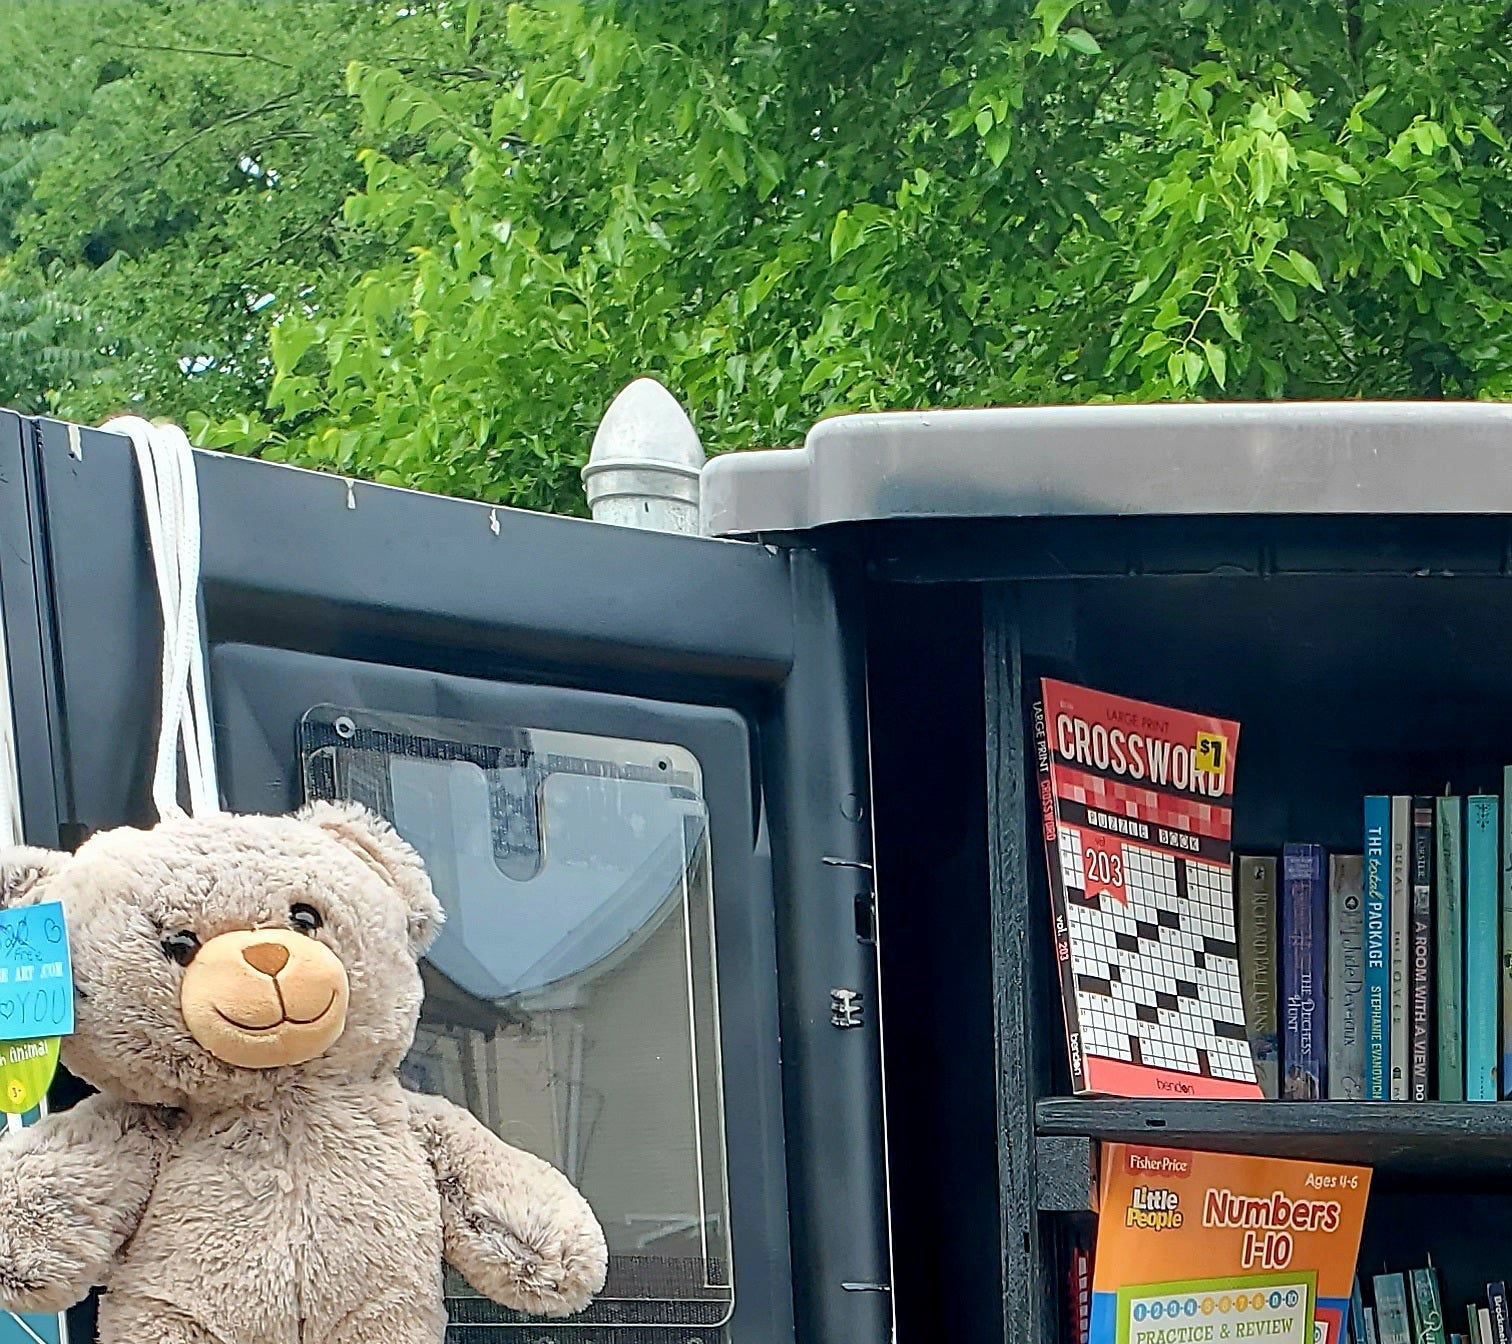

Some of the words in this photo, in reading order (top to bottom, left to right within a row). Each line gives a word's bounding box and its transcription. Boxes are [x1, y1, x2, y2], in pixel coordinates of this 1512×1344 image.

[1033, 701, 1045, 740] LARGE
[1038, 740, 1048, 772] PRINT
[1200, 738, 1223, 768] $1
[1088, 810, 1149, 839] PUZZLE
[1159, 829, 1199, 851] BOOK
[1369, 827, 1381, 855] THE
[1085, 847, 1123, 888] 203
[1369, 902, 1382, 968] PACKAGE
[1416, 921, 1427, 933] A
[1415, 937, 1427, 982] ROOM
[16, 986, 66, 1024] YOU
[1415, 988, 1427, 1023] WITH
[1415, 1024, 1425, 1038] A
[10, 1041, 48, 1063] Animal
[1415, 1042, 1424, 1078] VIEW
[1157, 1078, 1194, 1094] bendon
[1305, 1173, 1337, 1189] Ages
[1340, 1176, 1358, 1189] 4-6
[1133, 1187, 1178, 1211] Little
[1203, 1189, 1341, 1231] Numbers
[1126, 1208, 1183, 1231] People
[1242, 1231, 1293, 1269] 1-10
[1220, 1325, 1230, 1338] &
[1236, 1318, 1293, 1337] REVIEW
